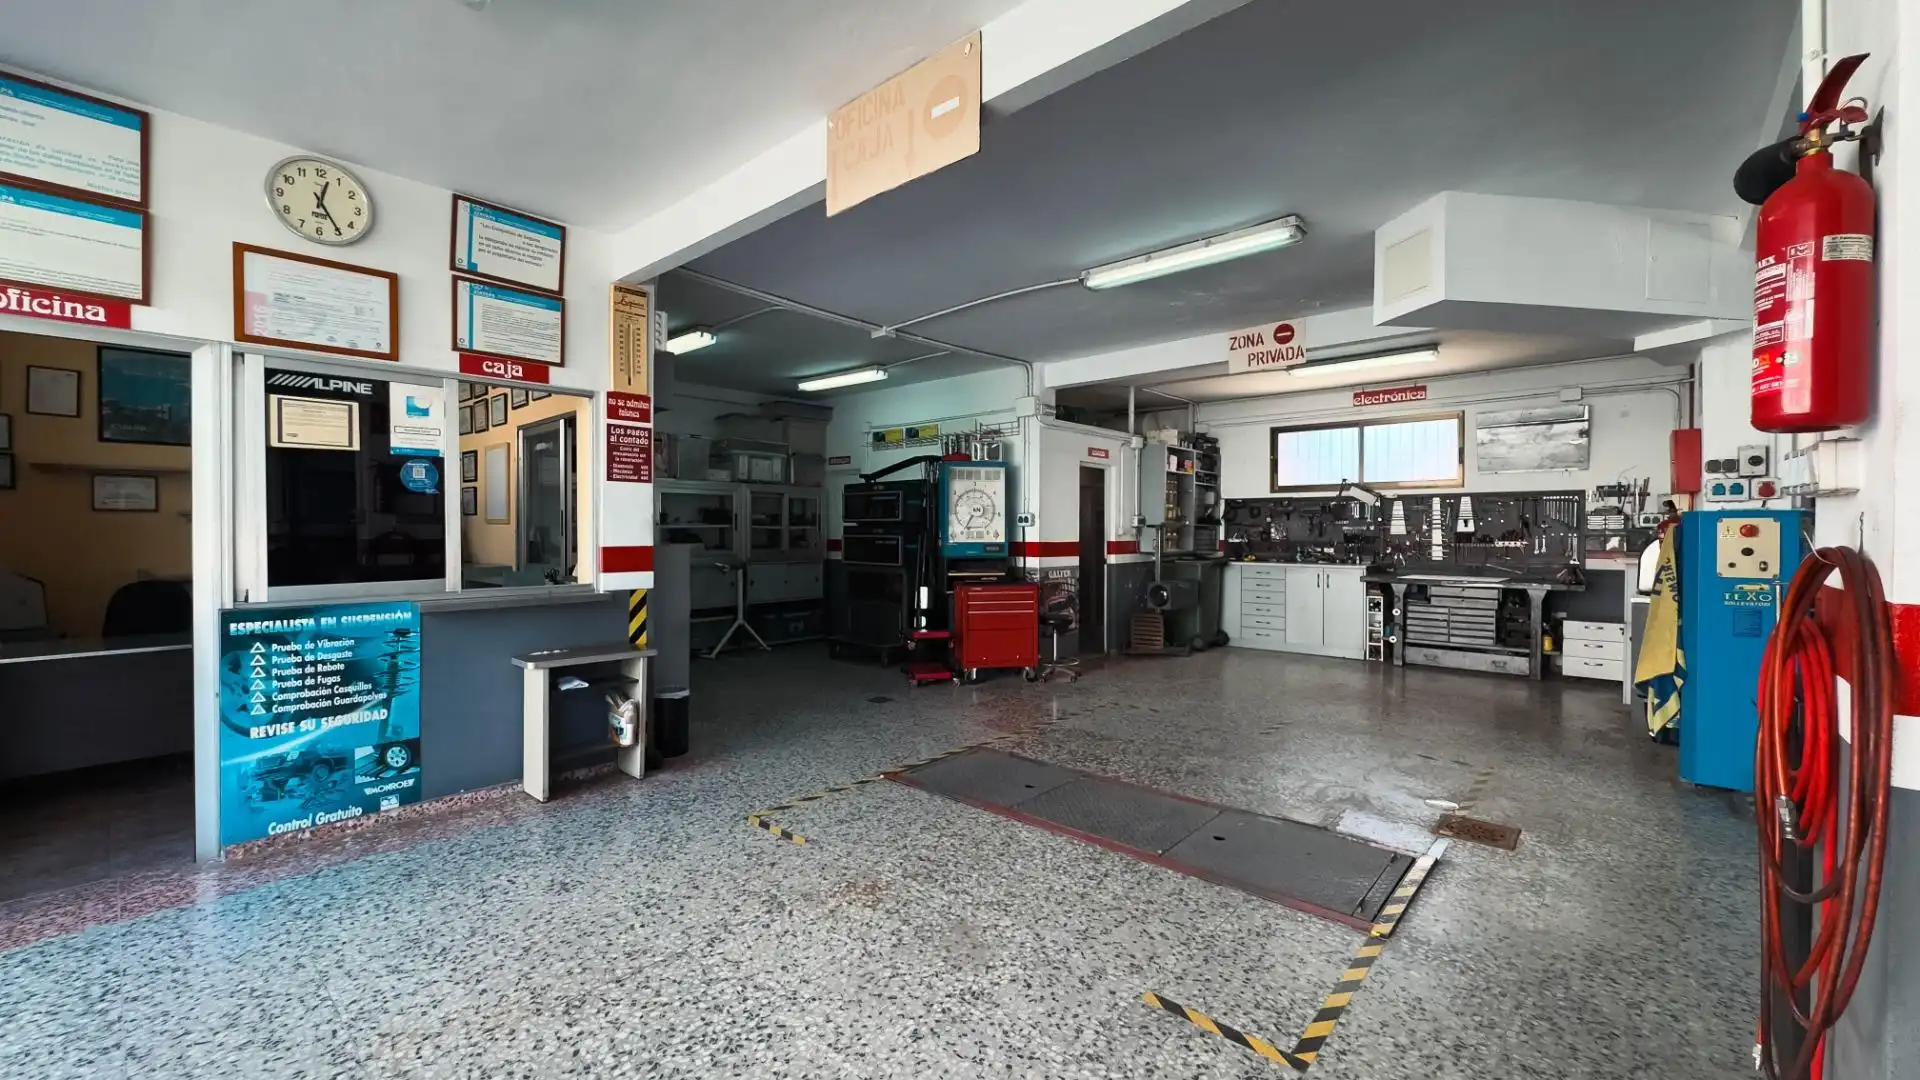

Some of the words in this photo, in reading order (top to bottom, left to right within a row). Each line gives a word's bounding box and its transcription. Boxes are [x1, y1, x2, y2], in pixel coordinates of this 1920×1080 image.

[836, 81, 905, 141] OFICINA
[844, 122, 893, 172] CAJA
[283, 174, 295, 185] 10
[297, 167, 306, 178] 11
[315, 167, 327, 178] 12
[335, 178, 341, 186] 1
[276, 187, 284, 197] 9
[348, 191, 356, 200] 2
[283, 205, 291, 214] 8
[354, 208, 362, 216] 3
[298, 219, 305, 228] 7
[347, 221, 354, 229] 4
[315, 227, 323, 236] 6
[1229, 332, 1264, 351] ZONA
[1247, 345, 1305, 367] PRIVADA
[482, 360, 523, 379] caja
[302, 377, 373, 395] ALPINE
[1353, 390, 1427, 406] electrónica
[610, 425, 625, 435] Los
[609, 434, 617, 442] al
[619, 436, 649, 445] contado
[1723, 591, 1772, 602] TEXO
[229, 617, 316, 636] ESPECIALISTA
[320, 617, 337, 629] EN
[341, 610, 412, 625] SUSPENSIÓN
[271, 642, 302, 653] Prueba
[304, 640, 315, 650] de
[317, 638, 355, 648] Vibración
[271, 654, 302, 665] Prueba
[304, 652, 315, 662] de
[317, 651, 353, 663] Desgaste
[271, 667, 302, 678] Prueba
[304, 665, 315, 675] de
[317, 662, 345, 673] Rebote
[271, 679, 302, 690] Prueba
[304, 677, 315, 687] de
[317, 675, 341, 687] Fugas
[271, 687, 332, 703] Comprobación
[333, 682, 372, 696] Casquillos
[271, 698, 332, 714] Comprobación
[333, 691, 388, 708] Guardapolvos
[249, 721, 295, 739] REVISE
[299, 718, 316, 732] SU
[320, 708, 389, 729] SEGURIDAD
[366, 779, 413, 795] MONROE
[267, 812, 313, 836] Control
[315, 806, 363, 825] Gratuito
